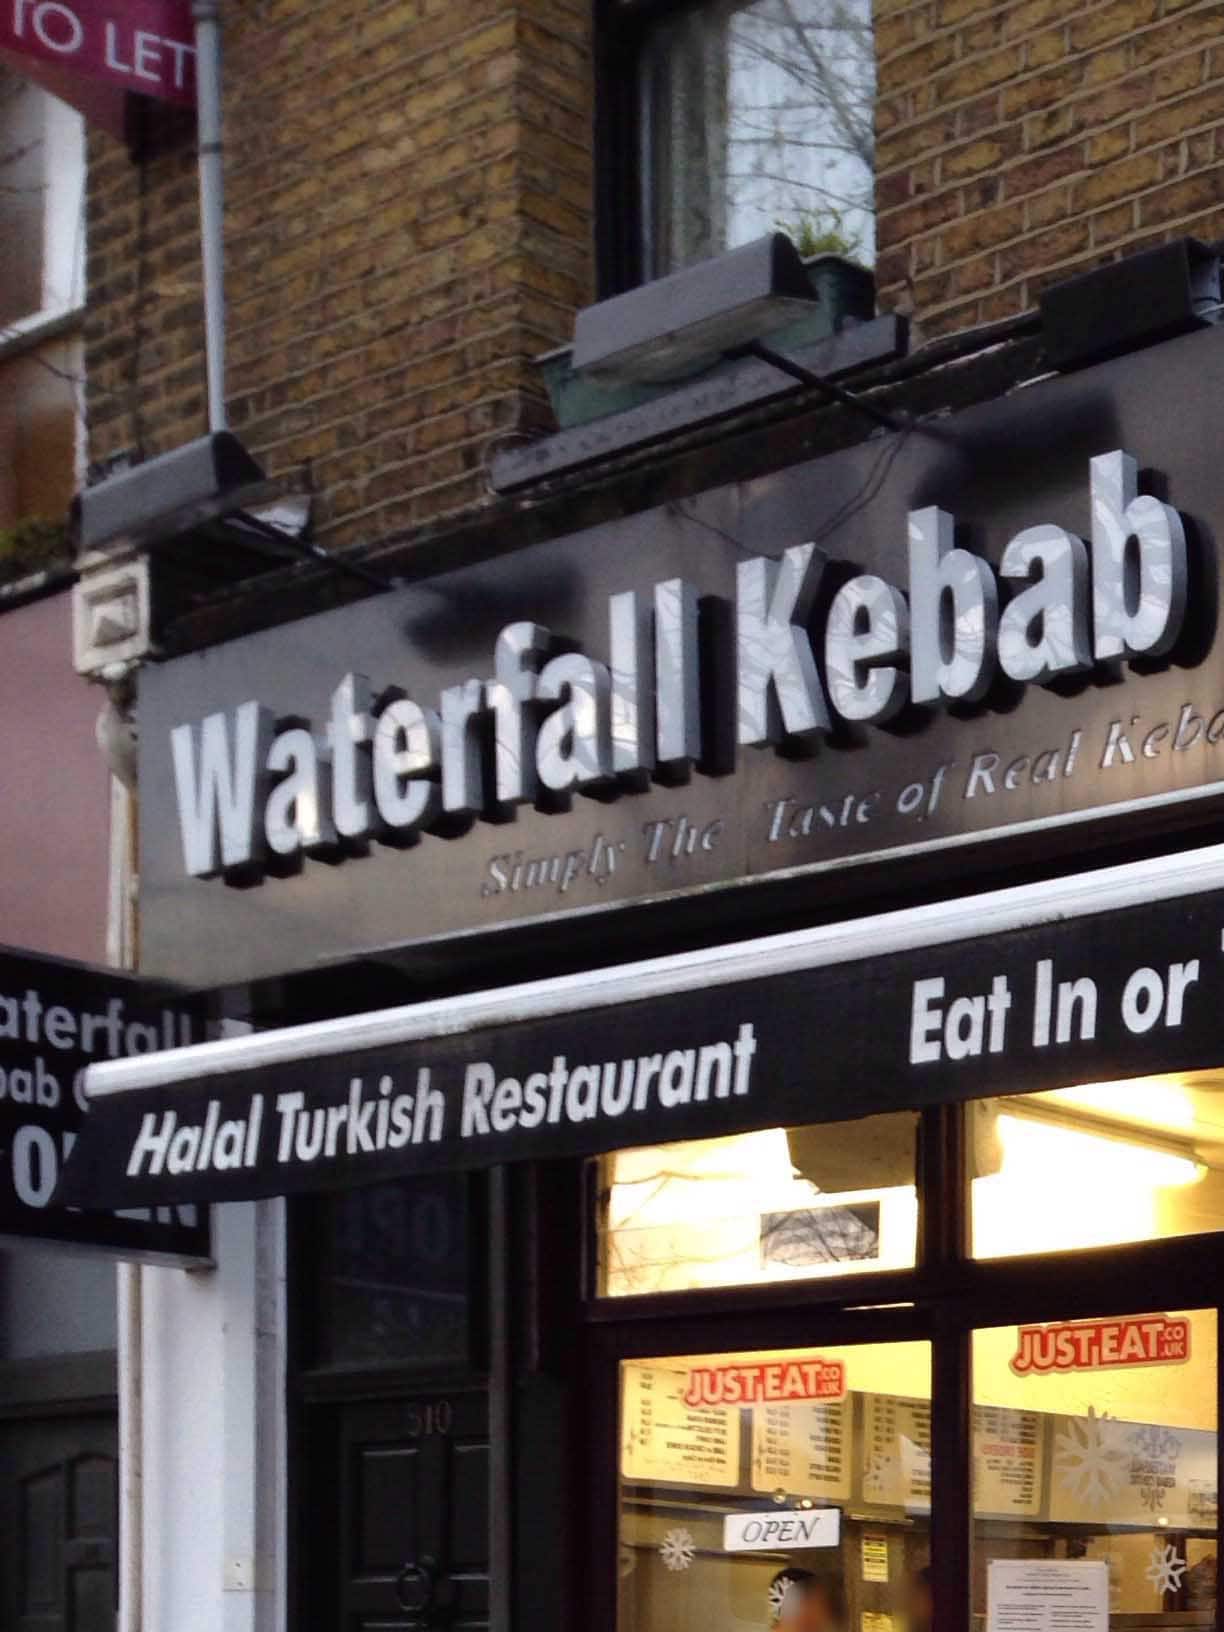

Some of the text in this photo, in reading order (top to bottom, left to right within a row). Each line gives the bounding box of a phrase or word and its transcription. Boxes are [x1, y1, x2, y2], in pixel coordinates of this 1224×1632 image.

[105, 21, 198, 89] LET
[171, 578, 698, 878] Waterfall
[736, 449, 1188, 746] Kebab
[481, 832, 625, 897] Simply
[643, 815, 724, 863] The
[768, 794, 881, 841] Taste
[896, 760, 955, 822] of
[964, 728, 1084, 800] Real
[909, 974, 1012, 1065] Eat
[1032, 958, 1097, 1047] In
[1122, 959, 1200, 1034] or
[127, 1092, 264, 1177] Halal
[277, 1066, 445, 1163] Turkish
[461, 1022, 758, 1138] Restaurant
[741, 1516, 821, 1543] OPEN
